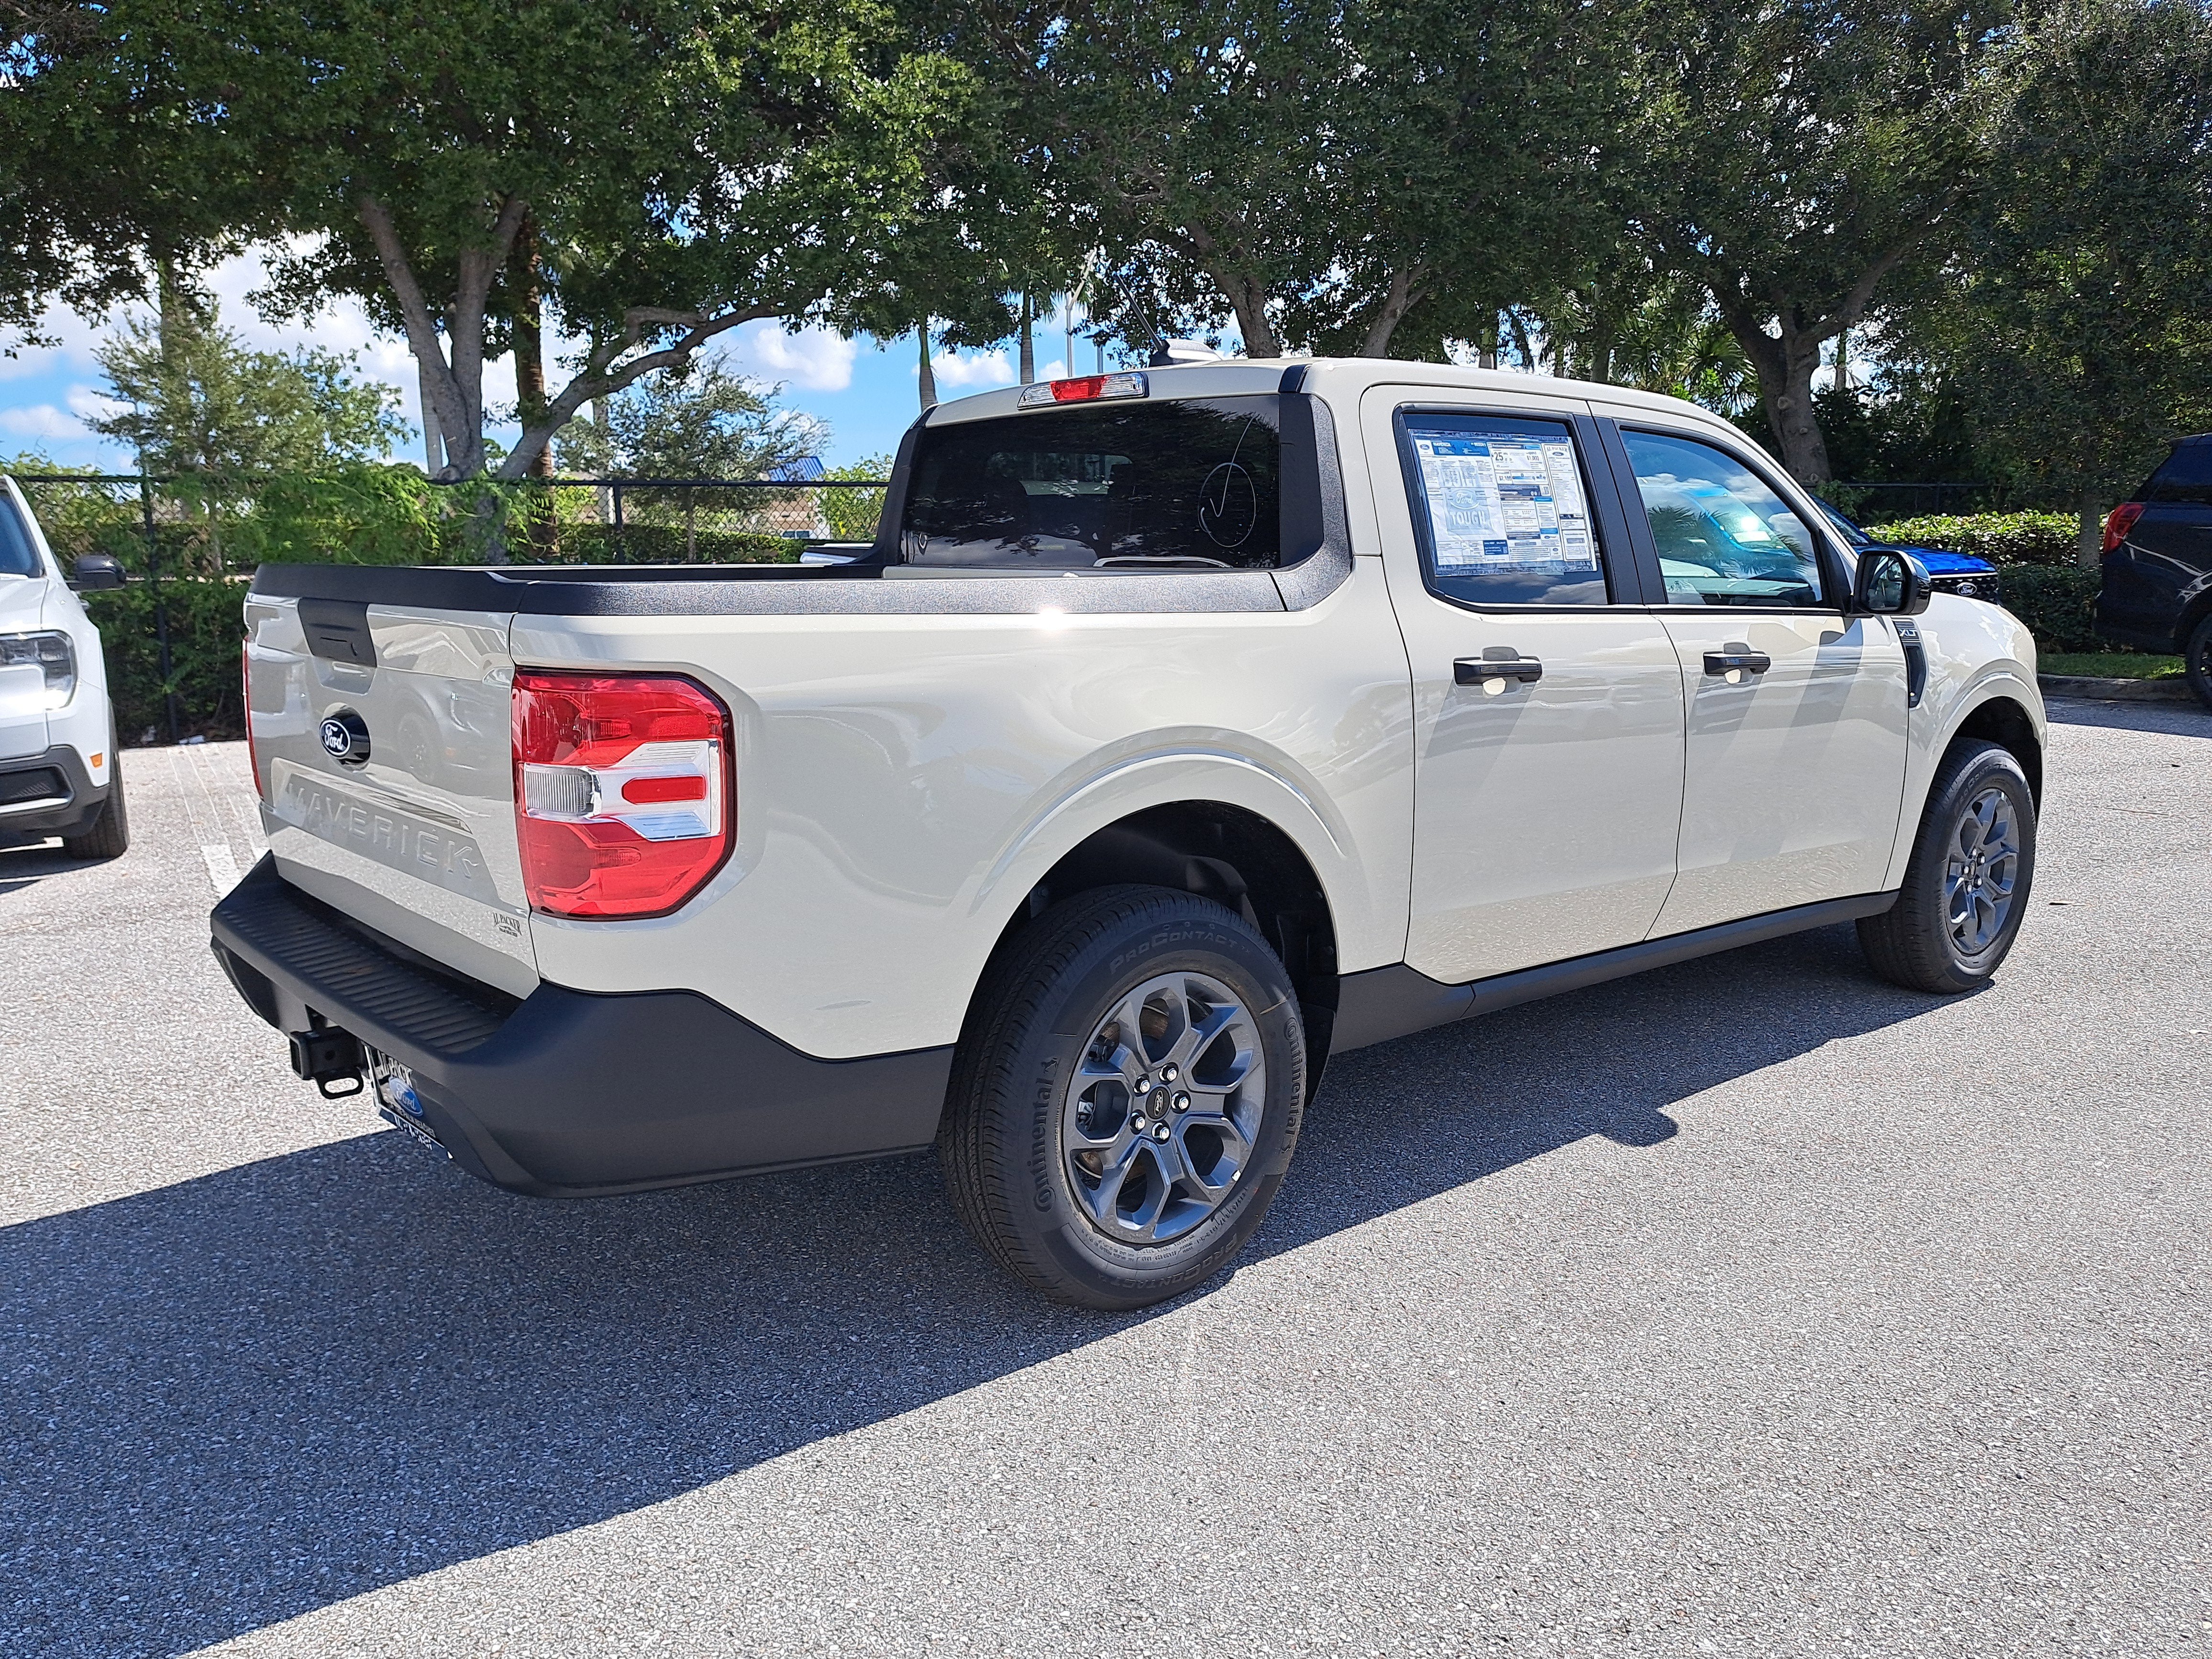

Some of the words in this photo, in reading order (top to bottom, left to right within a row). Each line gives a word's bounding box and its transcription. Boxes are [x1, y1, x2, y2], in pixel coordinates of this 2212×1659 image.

[1494, 452, 1504, 461] 25
[1449, 510, 1486, 526] TOUGH
[1898, 629, 1917, 637] XLT
[324, 724, 344, 751] Ford
[286, 782, 479, 879] MAVERICK
[499, 914, 522, 936] PACKER
[1284, 1017, 1303, 1136] Continental
[1027, 1077, 1056, 1213] Continental
